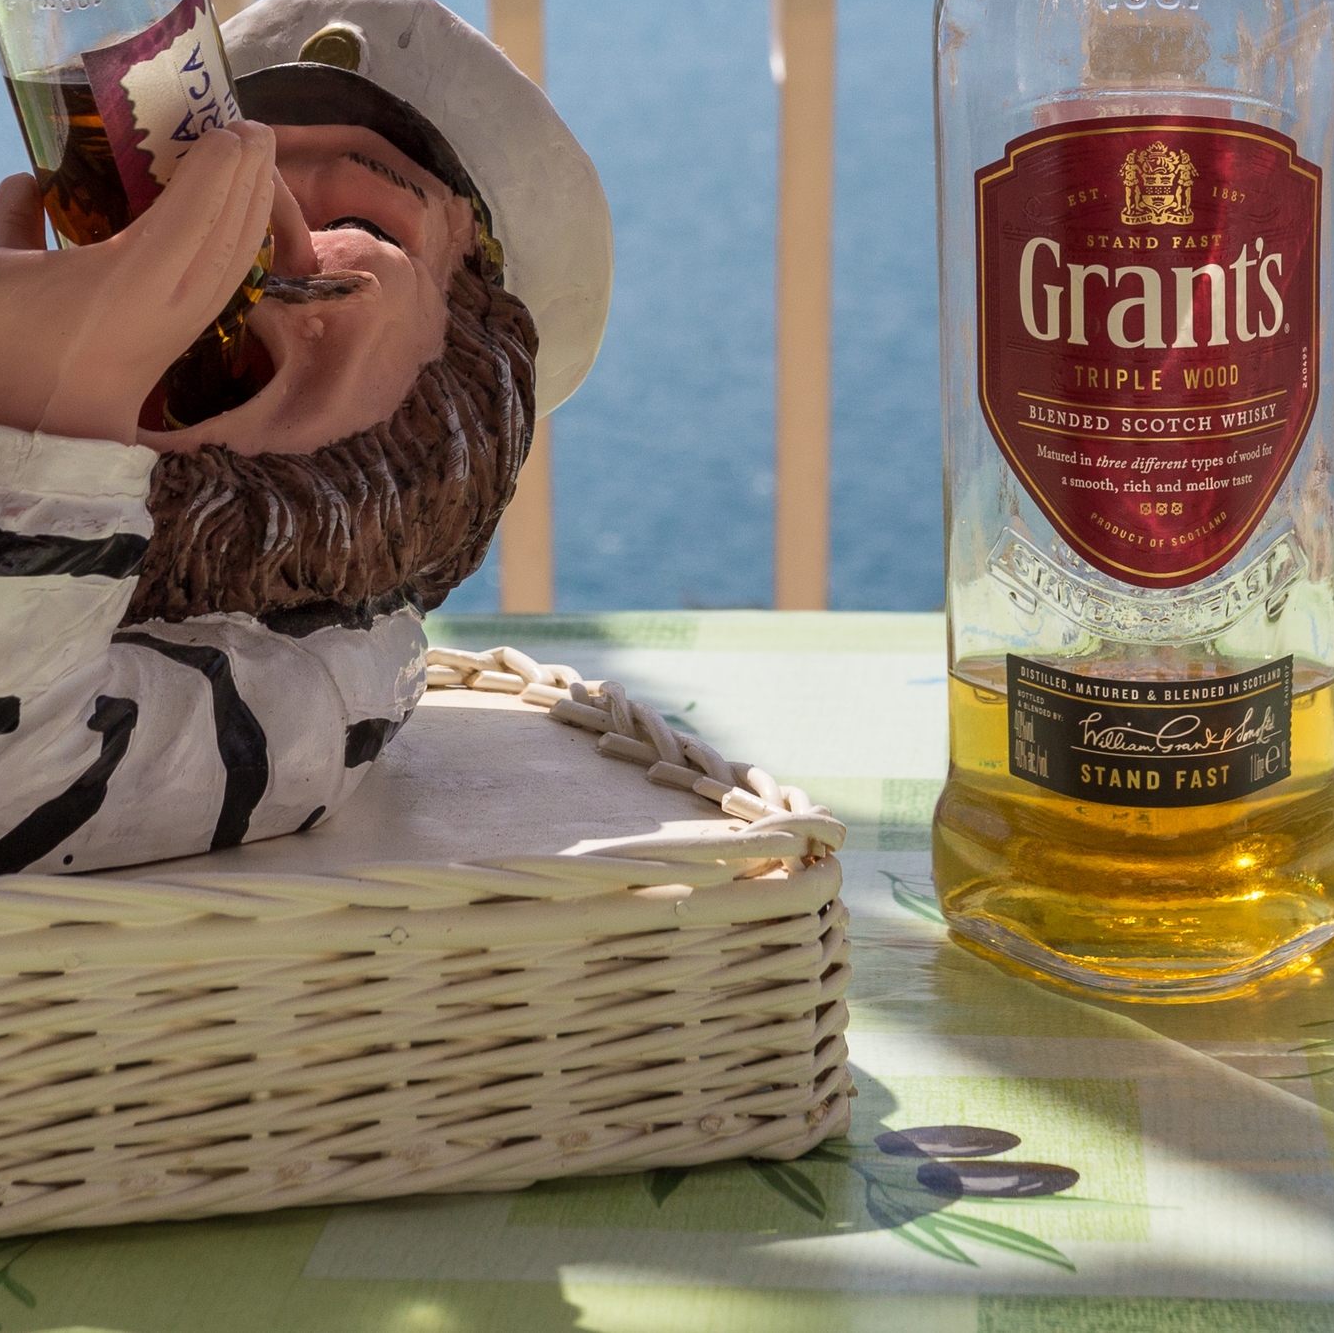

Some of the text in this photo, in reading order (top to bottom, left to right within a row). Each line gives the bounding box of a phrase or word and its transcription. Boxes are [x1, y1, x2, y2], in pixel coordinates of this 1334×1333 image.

[1212, 186, 1246, 204] 1887
[1124, 215, 1191, 224] STAND FAST
[1086, 233, 1222, 249] STAND FAST
[1019, 236, 1284, 349] Grant's
[1074, 364, 1239, 391] TRIPLE WOOD
[1028, 403, 1277, 433] BLENDED SCOTCH WHISKY
[1037, 443, 1273, 474] Matured in three different types of wood for
[1061, 473, 1253, 494] a smooth, rich and mellow taste
[1090, 511, 1227, 548] PRODUCT OF SCOTLAND
[1017, 689, 1045, 705] BOTTLED
[1020, 666, 1281, 701] DISTILLED, MATURED & BLENDED IN SCOTLAND
[1017, 699, 1022, 708] &
[1024, 702, 1052, 718] BLENDED
[1078, 711, 1156, 753] William
[1081, 763, 1229, 790] STAND FAST
